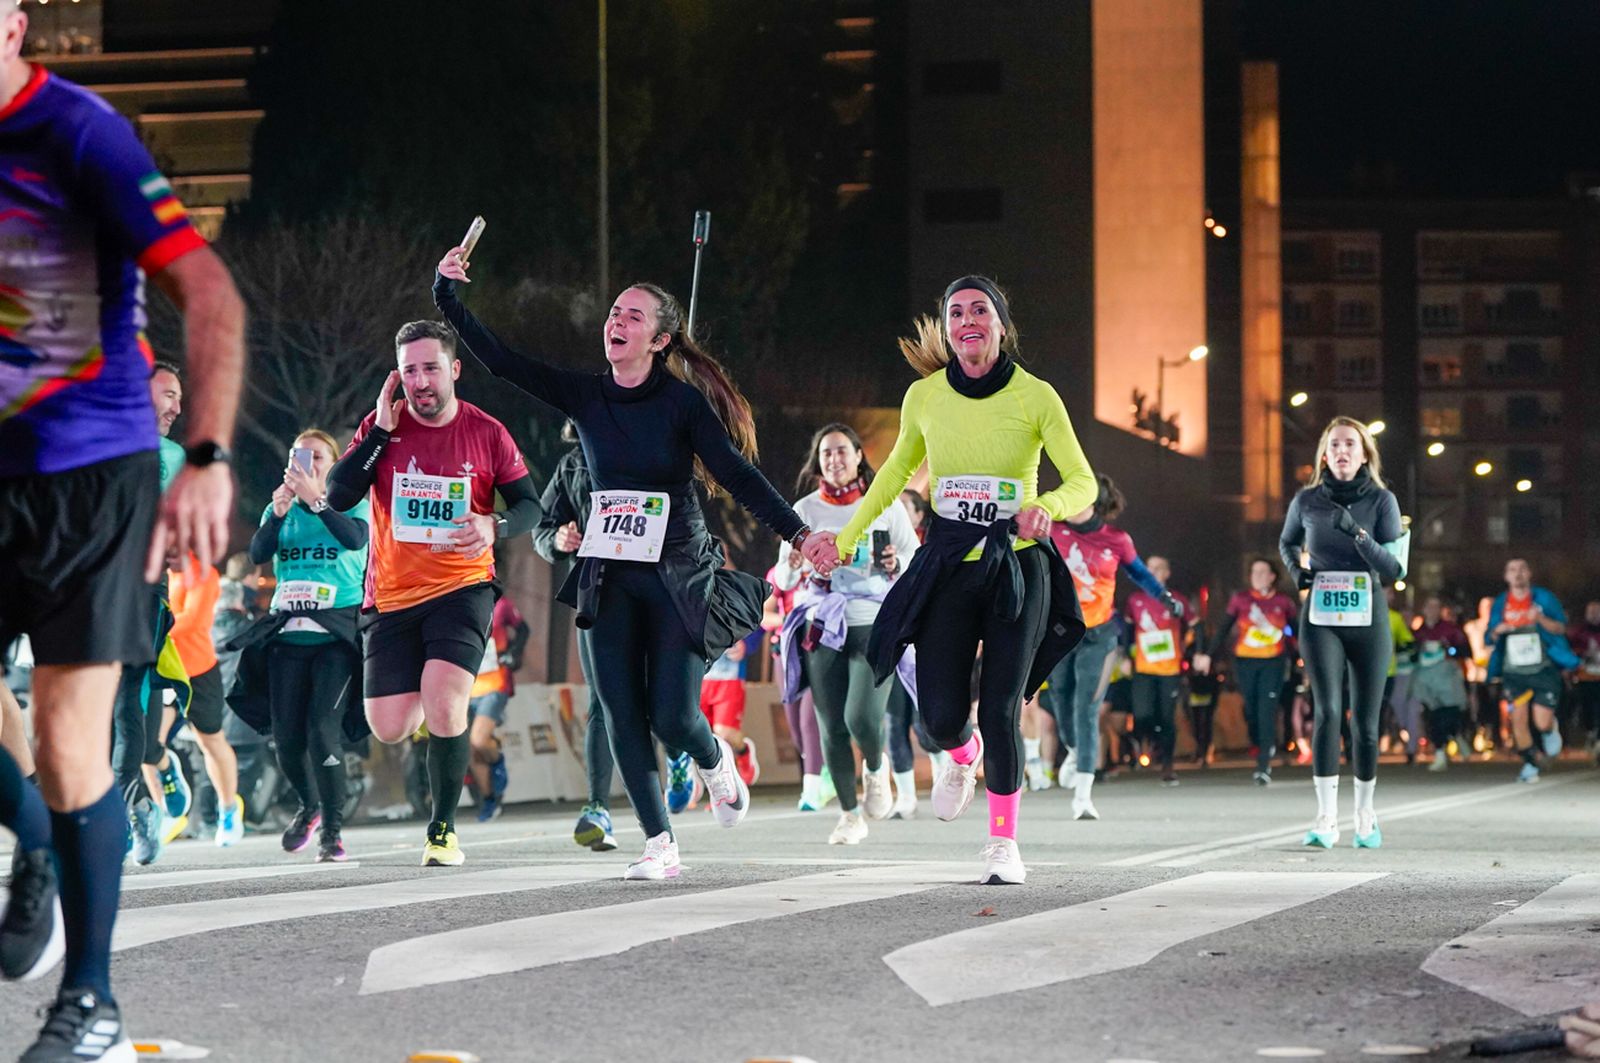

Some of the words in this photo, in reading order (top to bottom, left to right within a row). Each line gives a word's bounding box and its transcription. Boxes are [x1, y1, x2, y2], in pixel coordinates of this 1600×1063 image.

[362, 444, 382, 470] KIPRUN
[401, 489, 416, 497] SAN
[410, 482, 432, 490] NOCHE
[944, 490, 960, 498] SAN
[954, 481, 979, 490] NOCHE
[980, 483, 991, 491] DE
[408, 499, 453, 521] 9148
[958, 500, 998, 522] 340
[603, 514, 647, 537] 1748
[280, 543, 338, 561] serás
[1323, 591, 1359, 607] 8159
